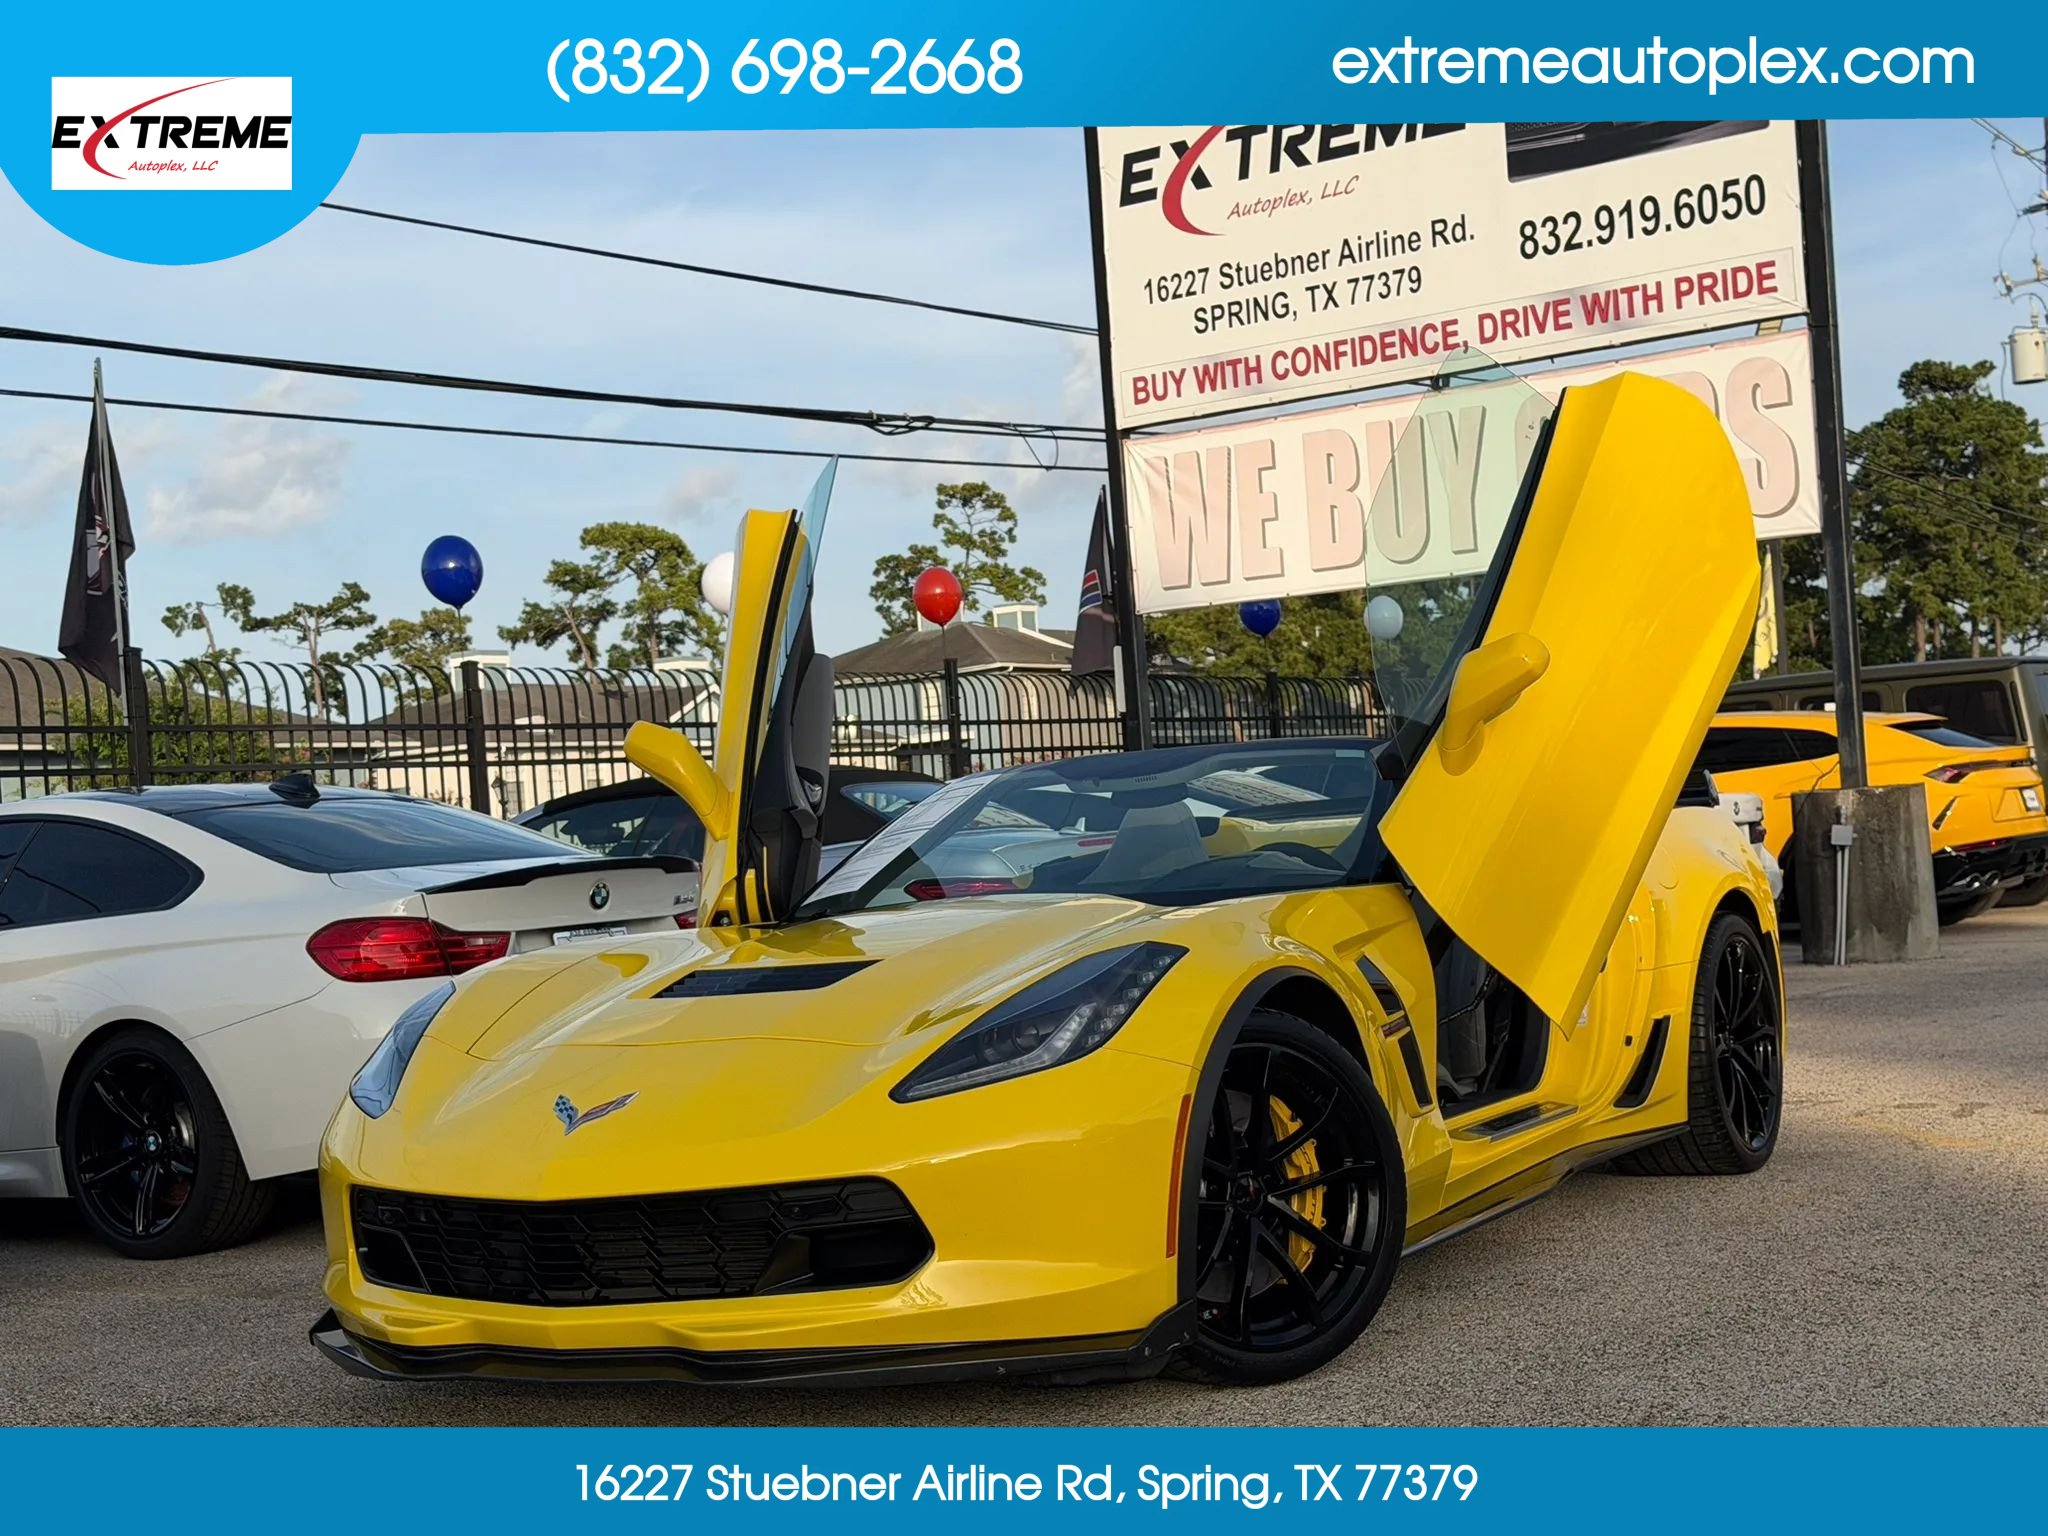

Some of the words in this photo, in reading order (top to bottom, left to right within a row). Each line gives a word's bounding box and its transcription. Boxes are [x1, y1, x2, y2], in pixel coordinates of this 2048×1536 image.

[1227, 187, 1313, 220] Autoplex,
[1320, 175, 1360, 201] LLC
[1519, 173, 1767, 260] 832.919.6050
[1144, 267, 1210, 304] 16227
[1219, 248, 1331, 290] Stuebner
[1338, 229, 1421, 267] Airline
[1431, 214, 1475, 248] Rd.
[1194, 291, 1297, 334] SPRING,
[1305, 281, 1340, 313] TX
[1347, 265, 1423, 306] 77379
[1132, 367, 1187, 405] BUY
[1192, 354, 1263, 394] WITH
[1270, 318, 1470, 381] CONFIDENCE,
[1477, 297, 1573, 345] DRIVE
[1579, 281, 1664, 326] WITH
[1674, 260, 1778, 310] PRIDE
[1145, 438, 1285, 591] WE
[1302, 405, 1486, 573] BUY
